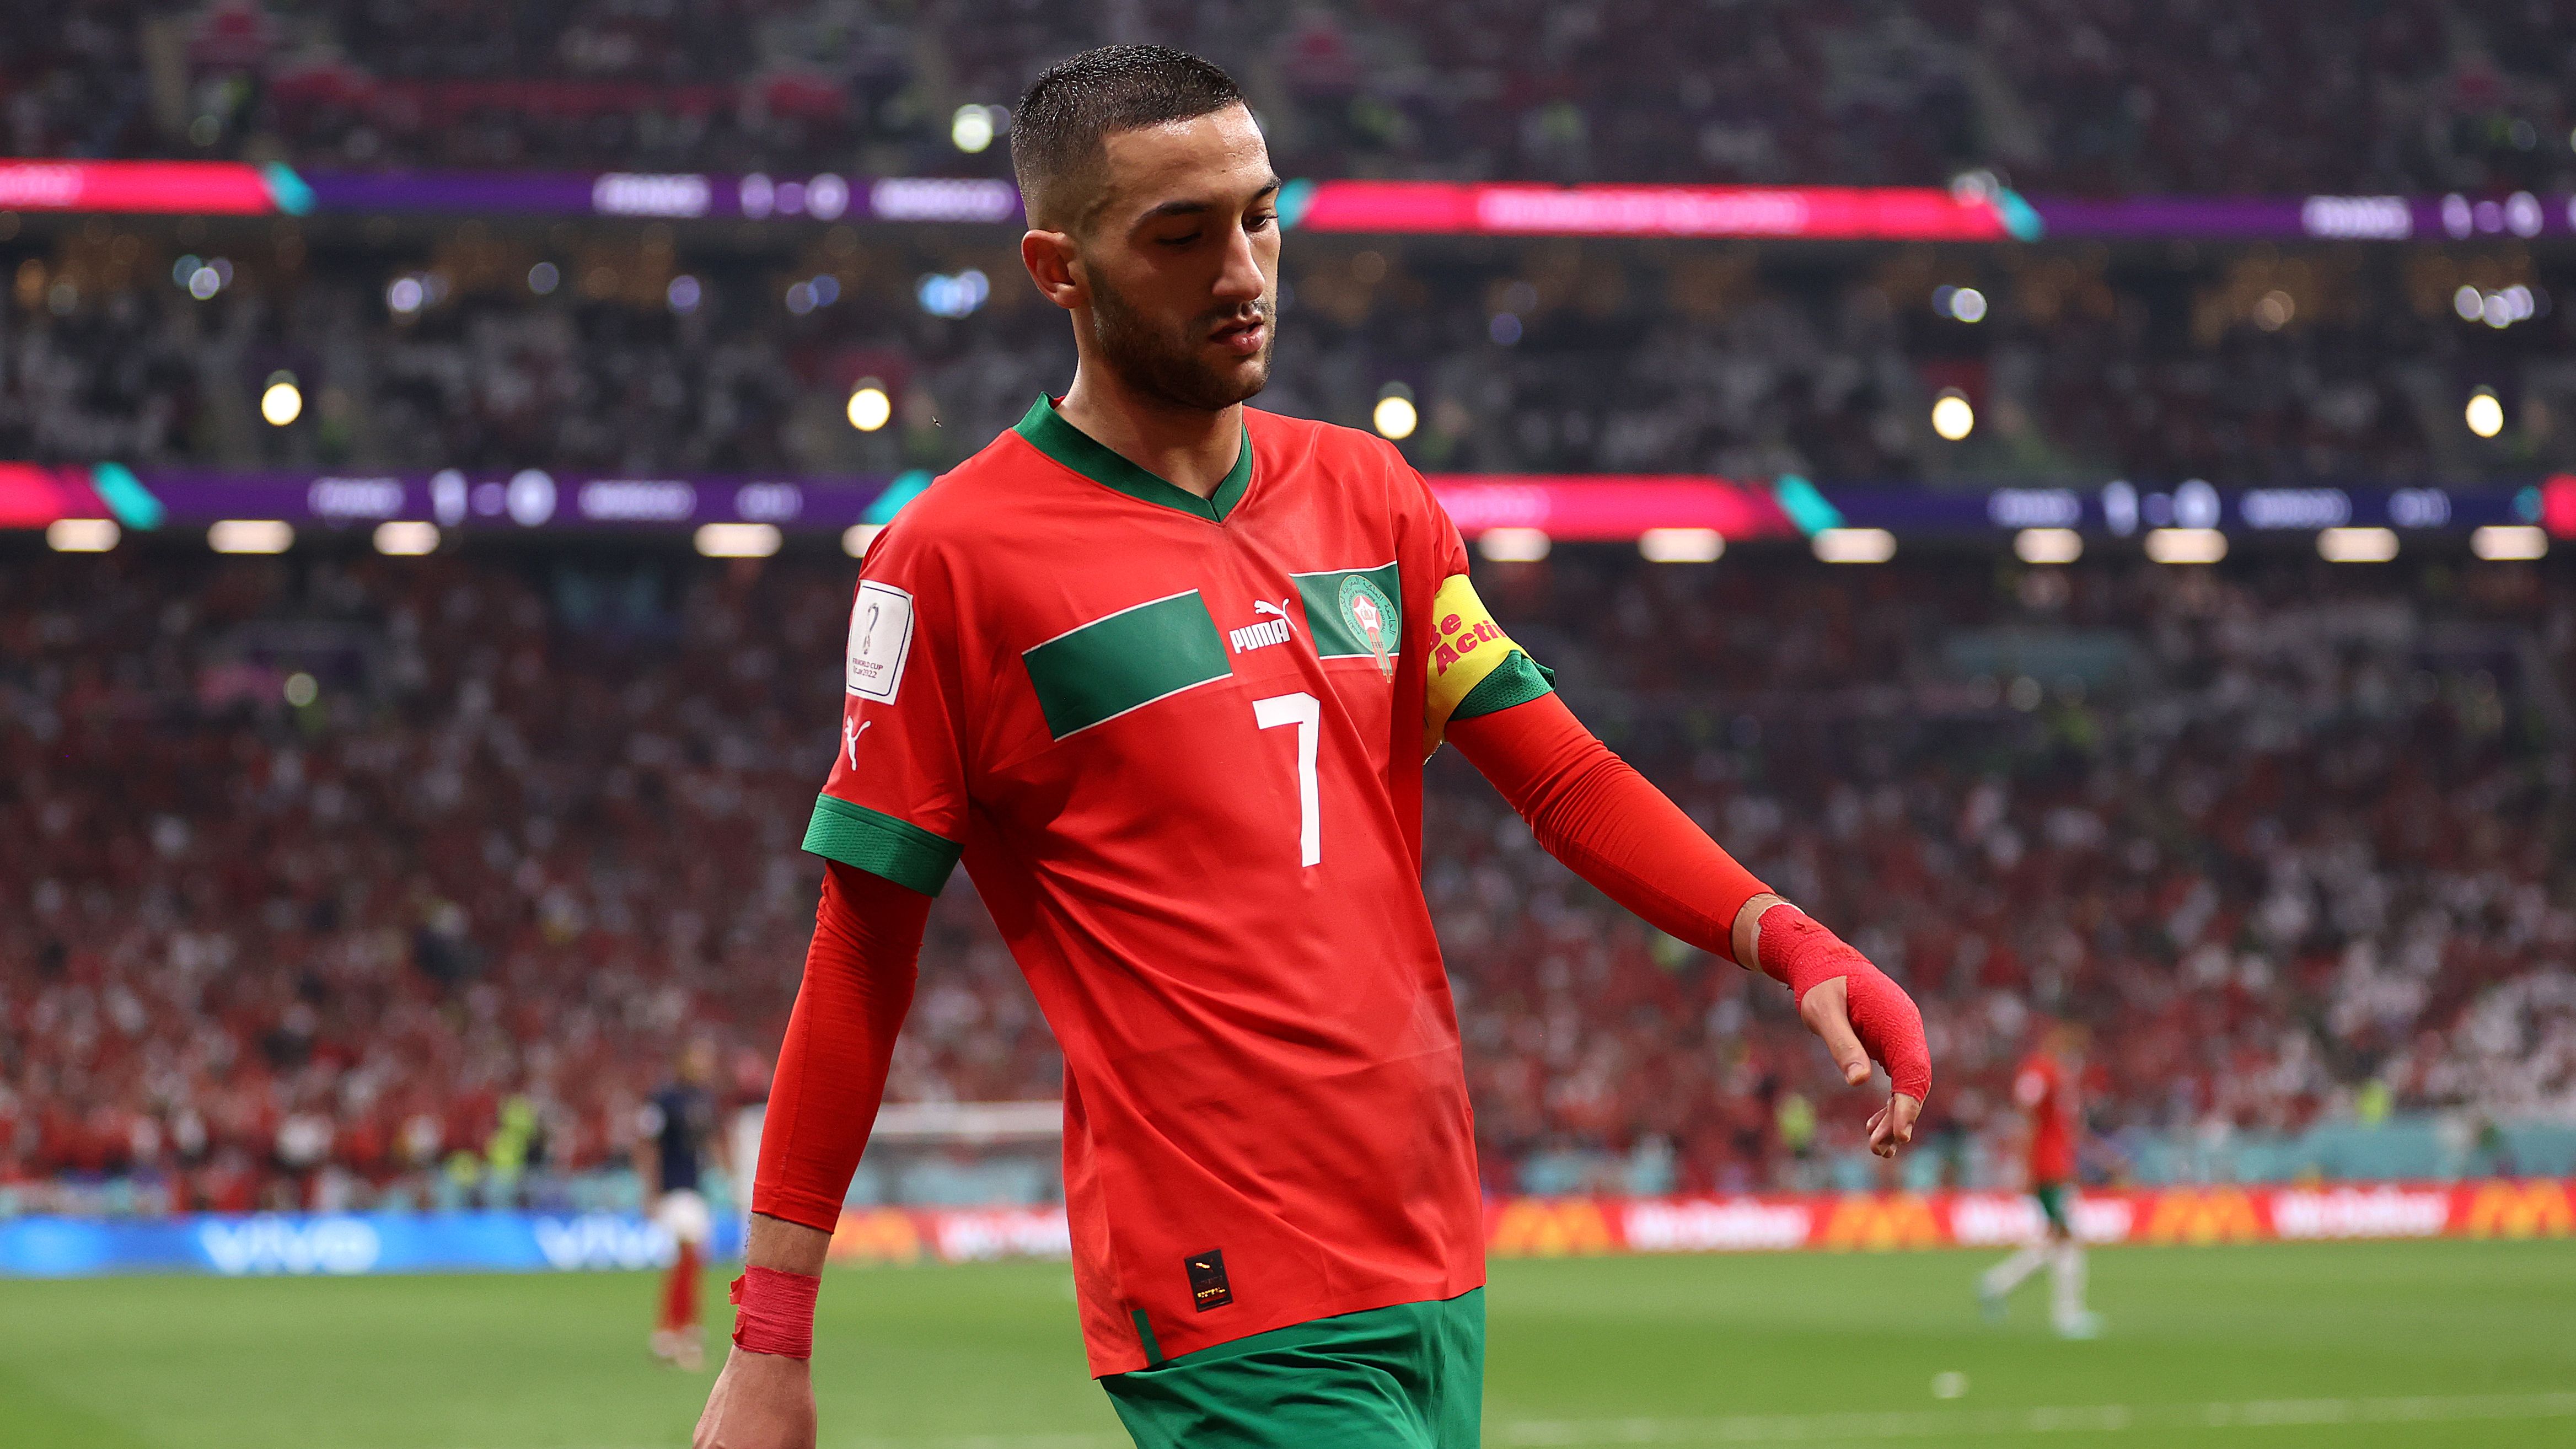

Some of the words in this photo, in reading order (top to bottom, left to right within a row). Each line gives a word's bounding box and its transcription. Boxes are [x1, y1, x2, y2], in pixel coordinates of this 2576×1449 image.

[1228, 618, 1291, 654] PUMA
[870, 662, 883, 670] CUP
[1252, 691, 1321, 868] 7
